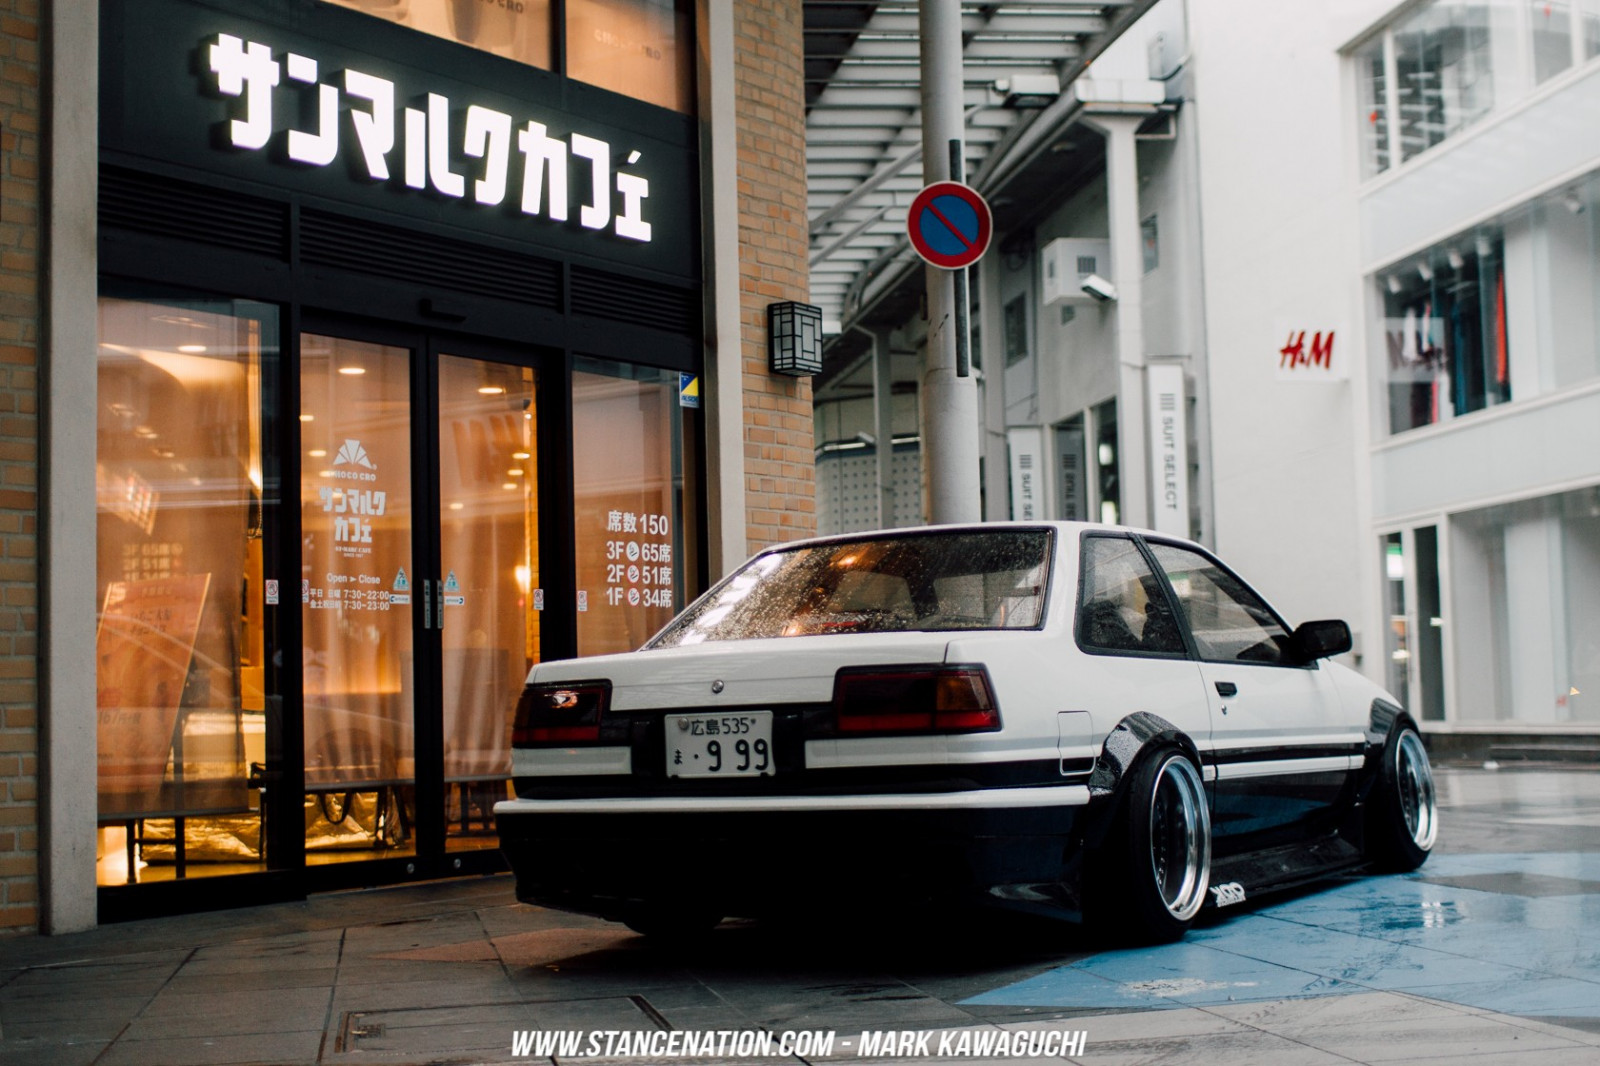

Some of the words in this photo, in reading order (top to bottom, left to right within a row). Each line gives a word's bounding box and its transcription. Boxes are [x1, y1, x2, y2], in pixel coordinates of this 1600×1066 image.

[209, 32, 652, 243] サンマルクカフェ
[1279, 330, 1334, 370] H&M
[1161, 416, 1175, 448] SUIT
[1164, 453, 1178, 510] SELECT
[319, 486, 386, 516] サンマルク
[334, 516, 372, 543] カフェ
[607, 510, 637, 533] 席数
[639, 513, 669, 536] 150
[606, 540, 625, 560] 3F
[641, 543, 672, 563] 65席
[326, 572, 348, 584] Open
[358, 574, 381, 585] Close
[606, 563, 625, 583] 2F
[641, 566, 672, 585] 51席
[606, 586, 624, 606] 1F
[642, 588, 673, 608] 34席
[691, 719, 720, 736] 広島
[722, 717, 750, 734] 535
[674, 749, 683, 765] ま
